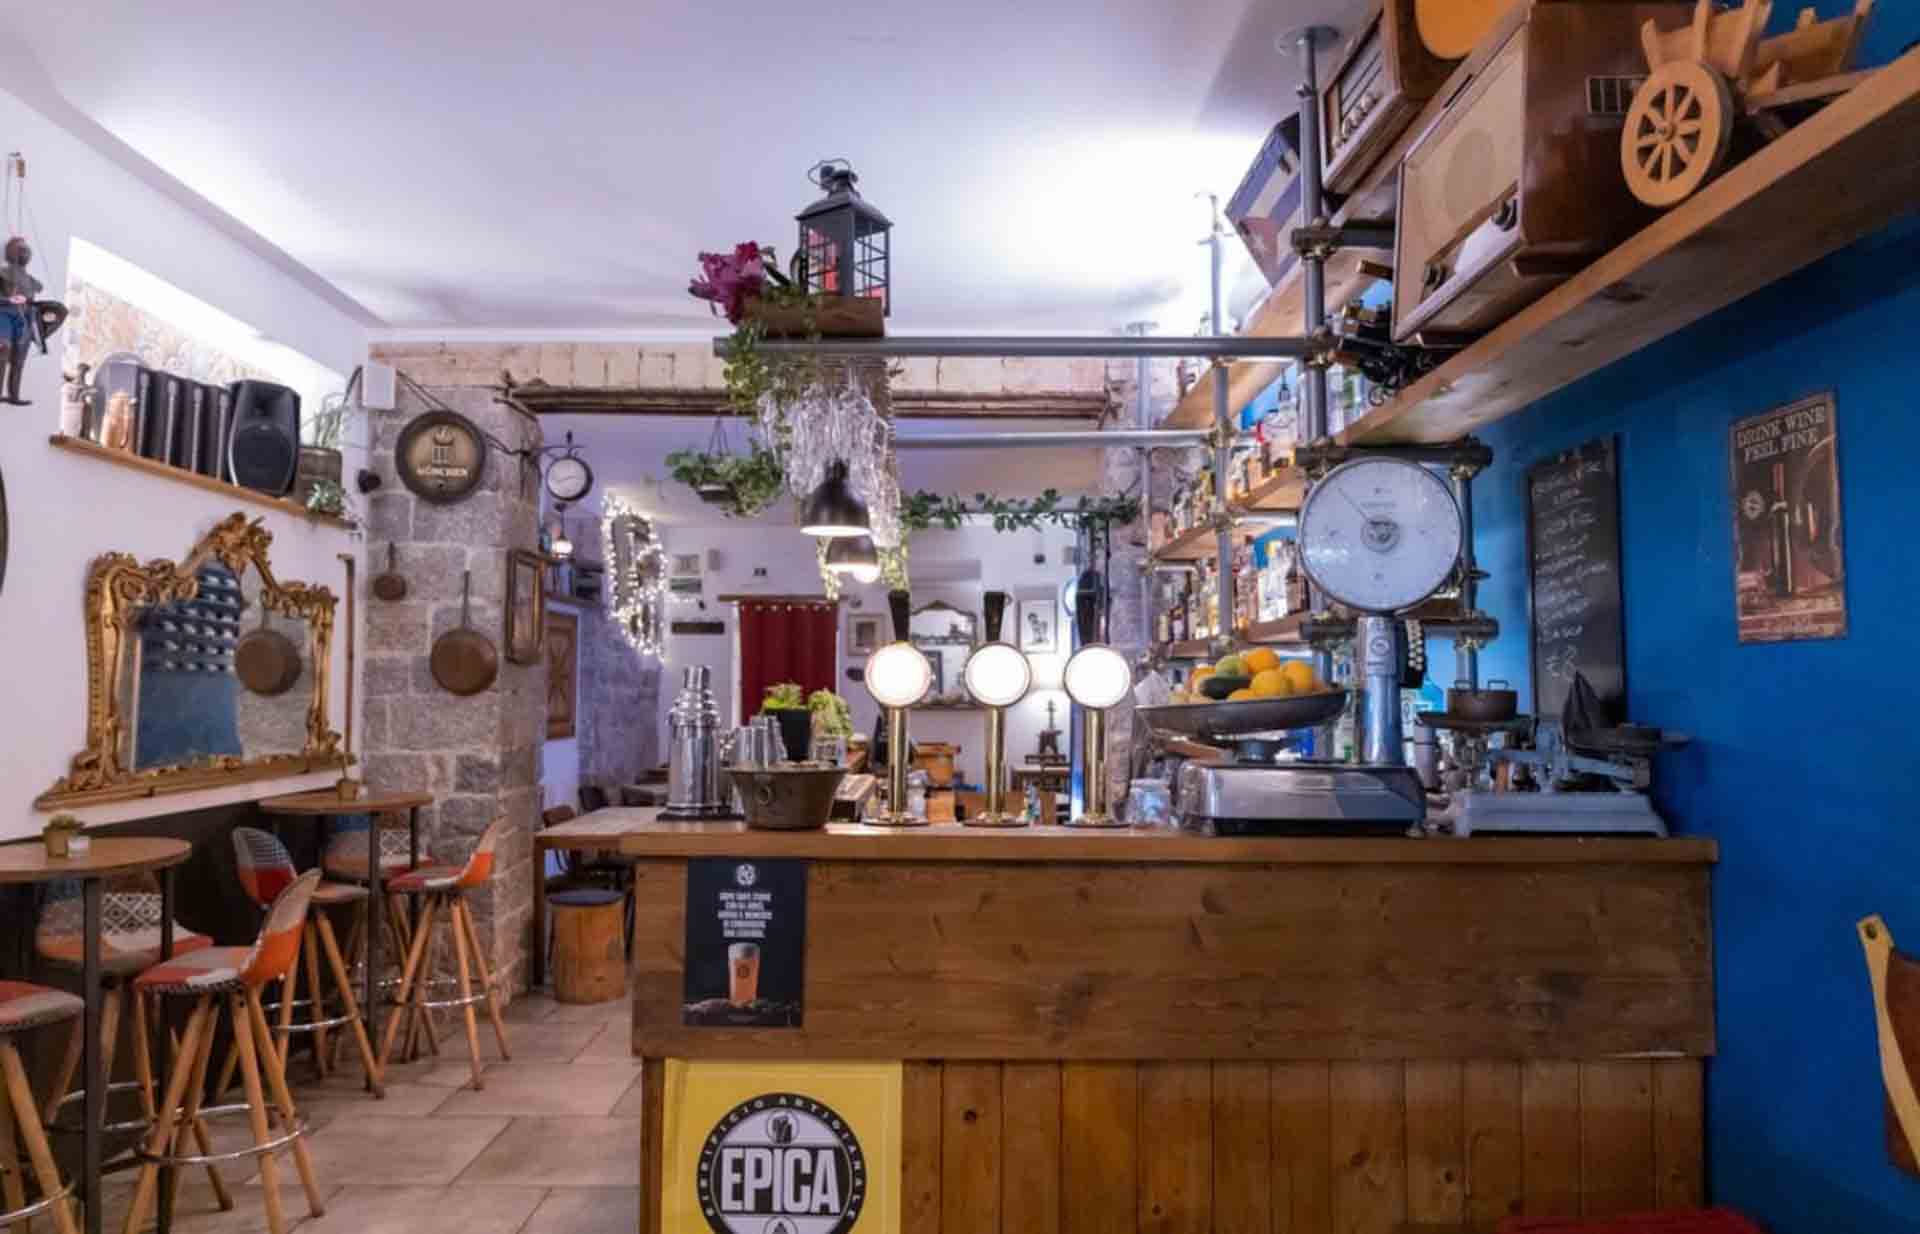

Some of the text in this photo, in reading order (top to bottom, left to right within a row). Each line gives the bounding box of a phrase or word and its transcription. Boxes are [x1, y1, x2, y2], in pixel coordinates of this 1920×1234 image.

[1736, 405, 1826, 449] DRINK WINE
[1744, 427, 1819, 464] FEEL FINE
[721, 1147, 841, 1214] EPICA
